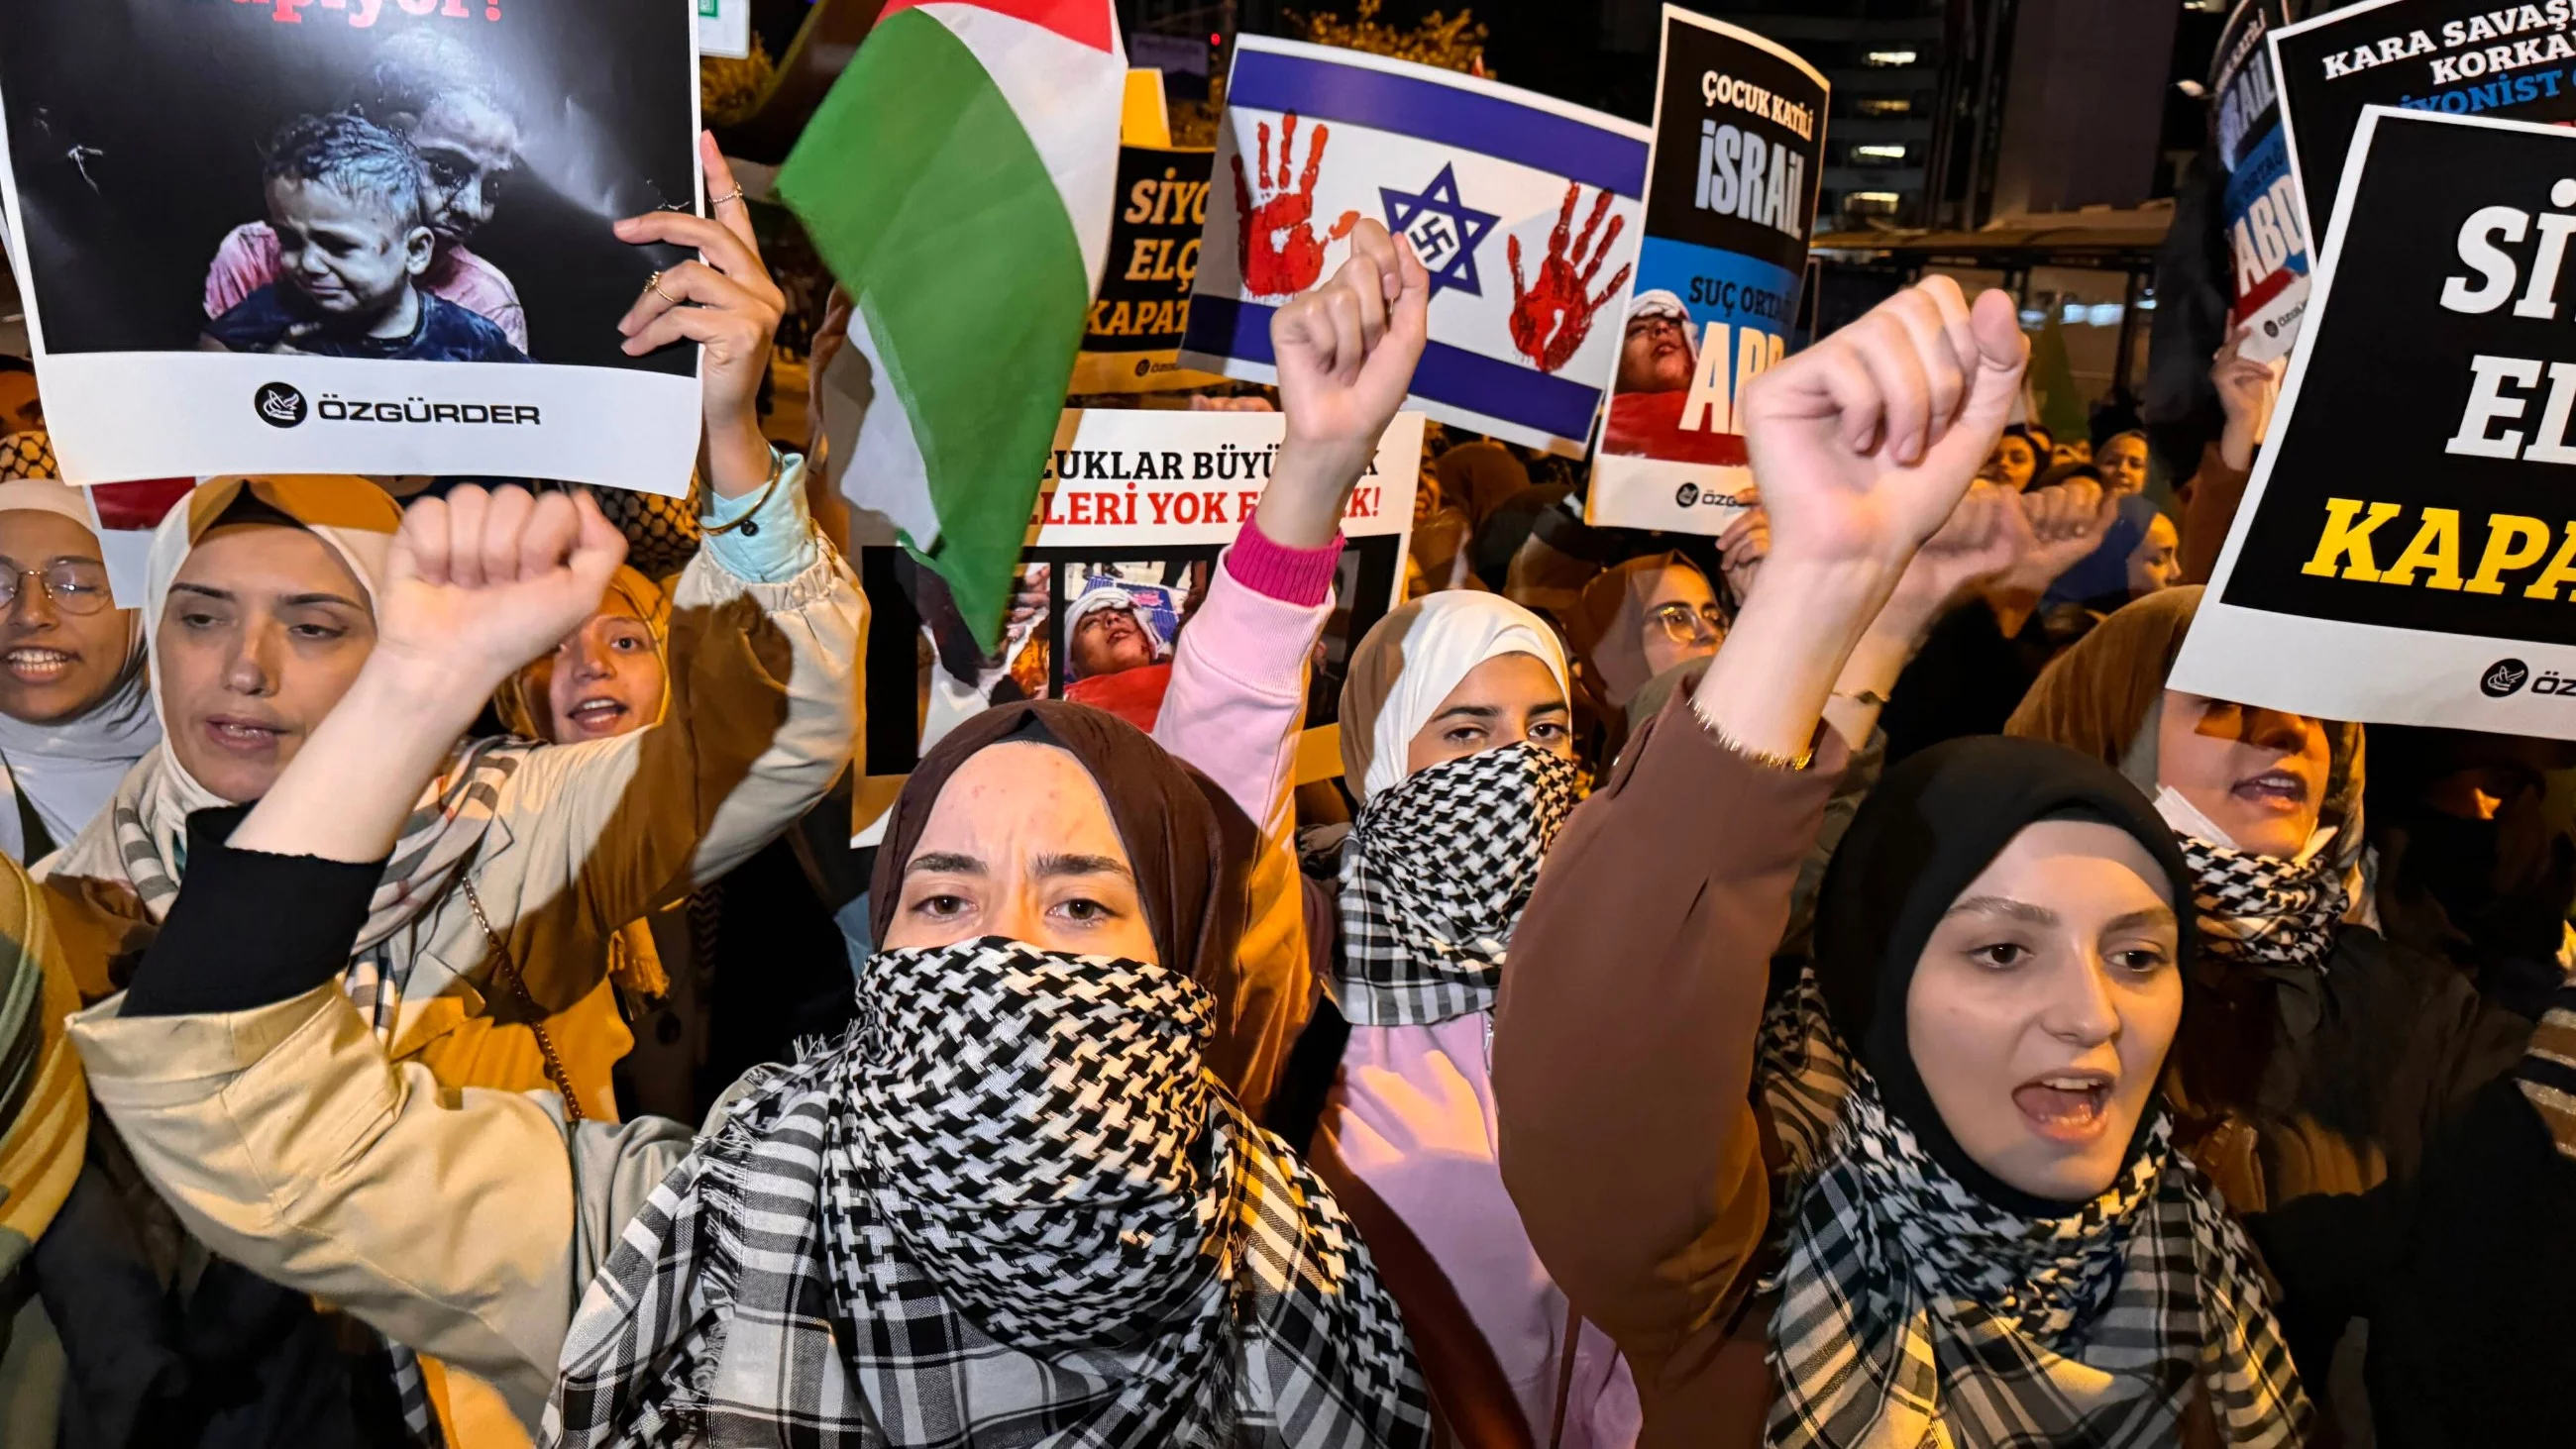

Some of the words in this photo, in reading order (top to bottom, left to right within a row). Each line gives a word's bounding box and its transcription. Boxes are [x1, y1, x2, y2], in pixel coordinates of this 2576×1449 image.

[2322, 30, 2437, 80] KARA
[2442, 0, 2576, 48] SAVAŞ
[2429, 31, 2576, 85] KORKA
[1702, 70, 1771, 118] ÇOCUK
[1771, 95, 1814, 142] KATİLİ
[1688, 275, 1737, 318] SUÇ
[317, 393, 541, 425] ÖZGÜRDER
[1043, 450, 1184, 480] UKLAR
[1028, 481, 1138, 525] LERİ
[1147, 490, 1228, 525] YOK
